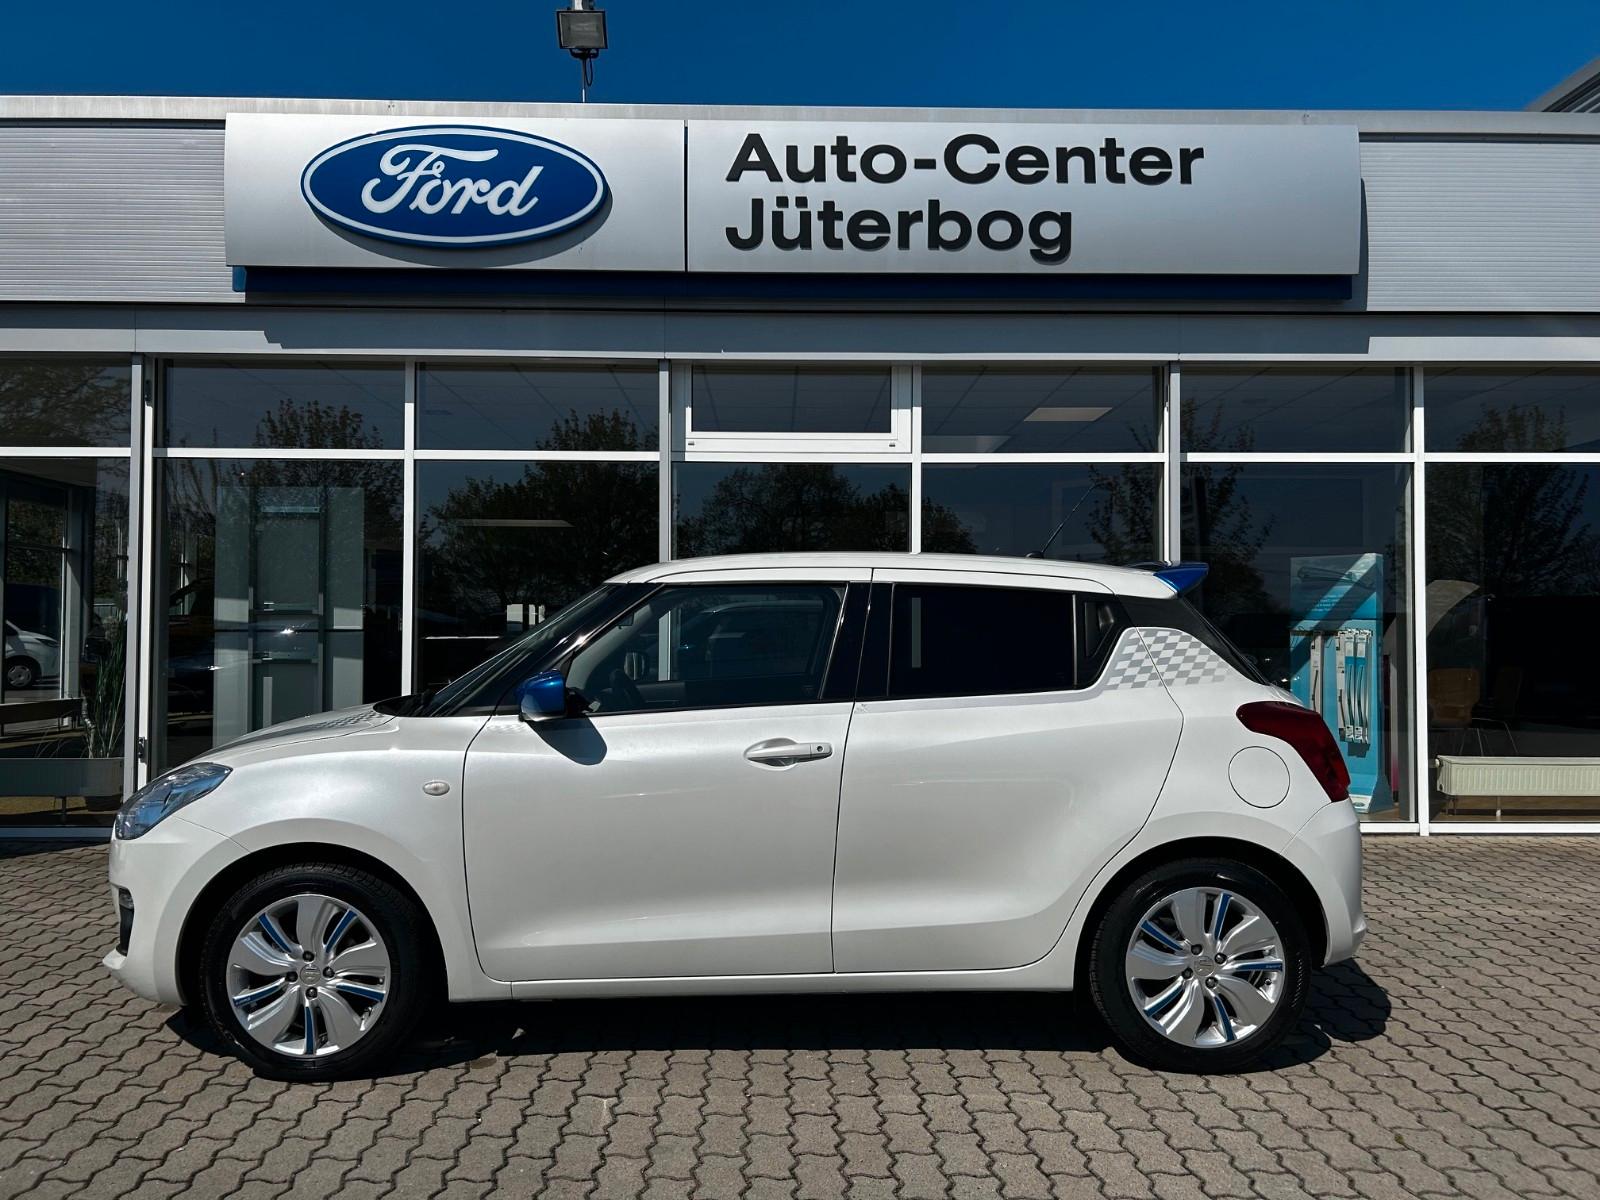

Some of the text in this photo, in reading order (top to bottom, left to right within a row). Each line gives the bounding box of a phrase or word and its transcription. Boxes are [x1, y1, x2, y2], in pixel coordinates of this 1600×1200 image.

[361, 144, 544, 216] Ford
[725, 133, 1204, 186] Auto-Center
[725, 196, 1072, 264] Jüterbog
